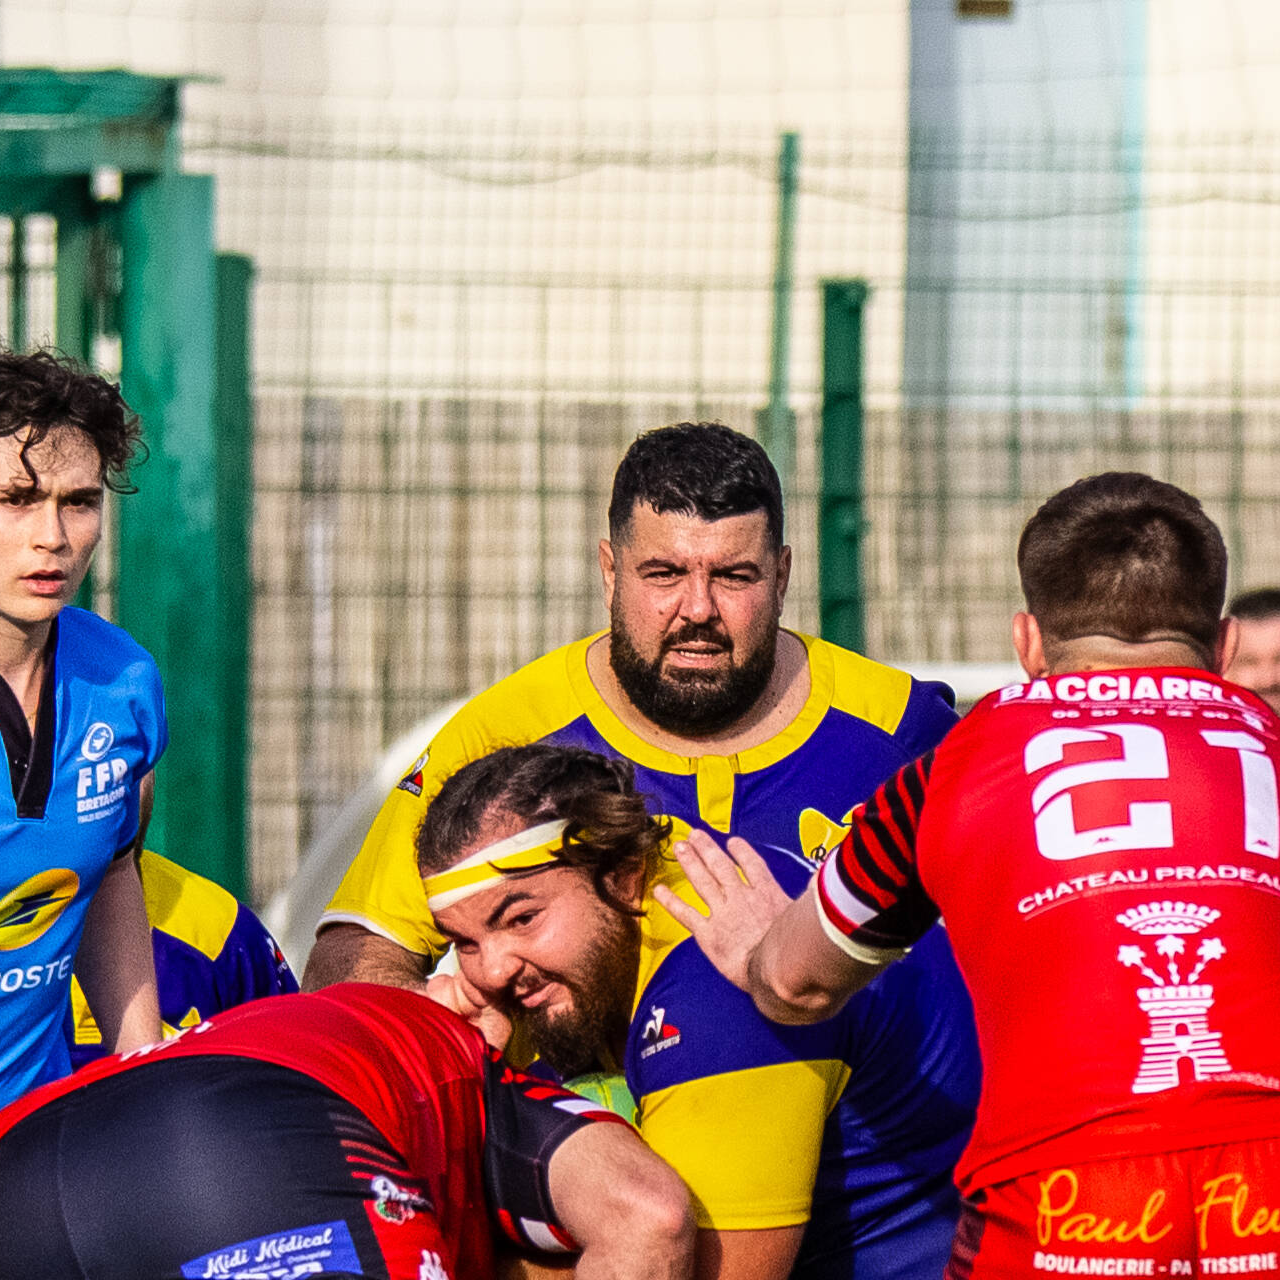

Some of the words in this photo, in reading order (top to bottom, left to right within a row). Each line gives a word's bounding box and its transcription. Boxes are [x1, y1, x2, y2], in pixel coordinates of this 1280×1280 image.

[1024, 722, 1280, 861] 21
[1018, 869, 1149, 914] CHATEAU
[1037, 1168, 1173, 1246] Paul
[202, 1249, 250, 1279] Midi
[255, 1227, 333, 1261] Médical
[1033, 1251, 1155, 1276] BOULANGERIE
